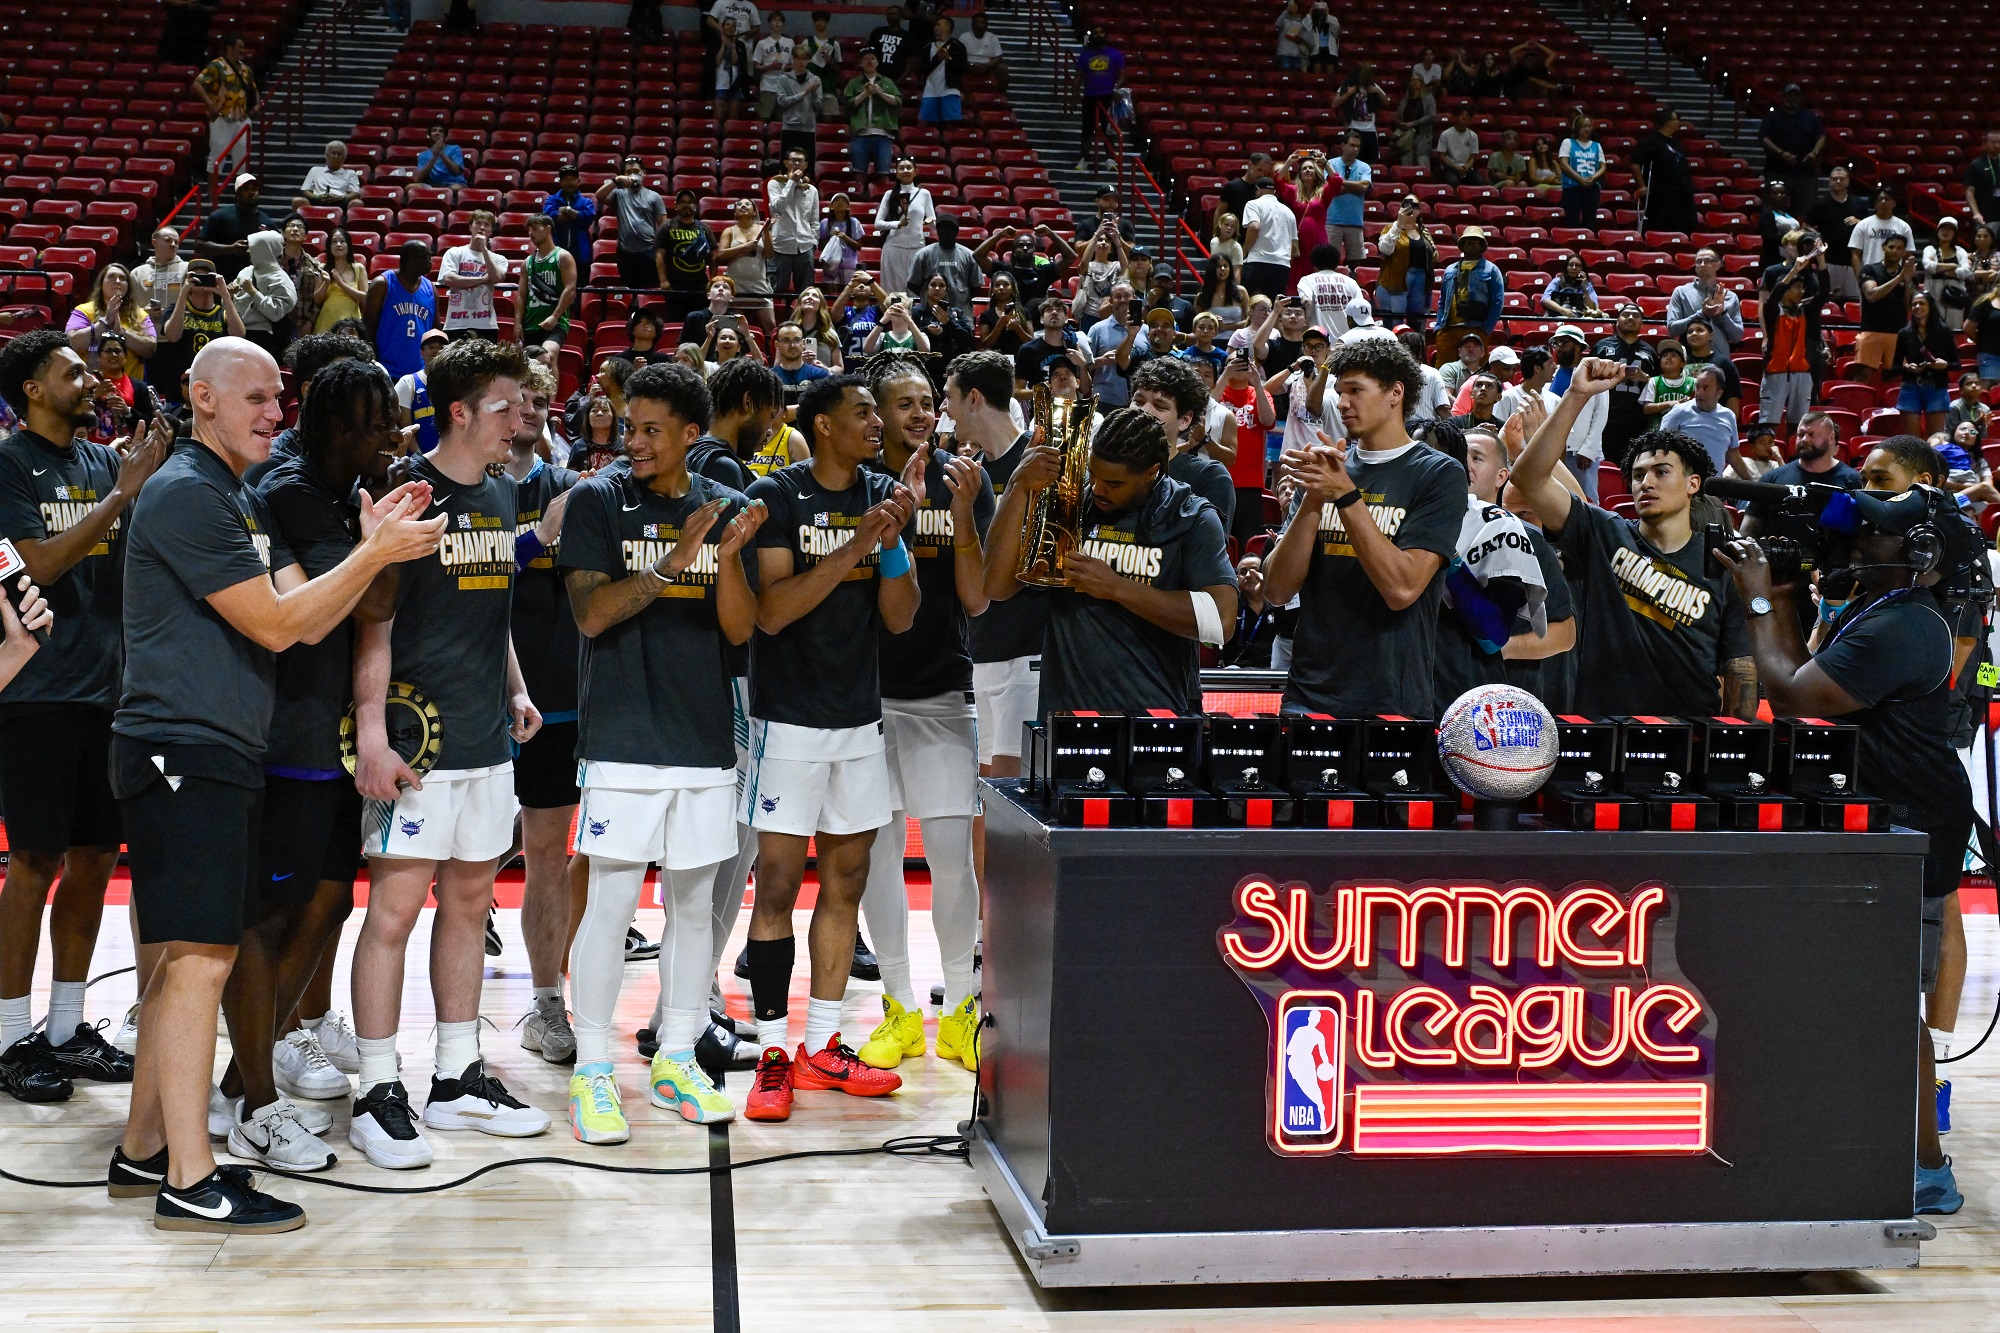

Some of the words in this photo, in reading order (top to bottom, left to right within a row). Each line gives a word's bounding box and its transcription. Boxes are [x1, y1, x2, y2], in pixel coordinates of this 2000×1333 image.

[879, 33, 902, 45] JUST
[881, 43, 896, 54] DO
[882, 53, 894, 64] IT.
[1314, 276, 1332, 284] GET
[1334, 275, 1346, 284] YA
[1318, 283, 1344, 293] MIND
[393, 302, 429, 321] THUNDER
[406, 320, 416, 338] 2
[852, 321, 877, 331] RNETS
[193, 332, 210, 354] 8
[745, 454, 786, 467] AKERS
[1467, 532, 1535, 565] GATOR
[1082, 539, 1163, 578] AMPIONS
[1610, 546, 1711, 620] CHAMPIONS
[1664, 607, 1694, 627] VEGAS
[1979, 664, 1996, 675] CAM
[1982, 674, 1989, 682] 4
[1496, 709, 1543, 731] SUMMER
[1499, 728, 1540, 748] LEAGUE
[1289, 1105, 1315, 1126] NBA
